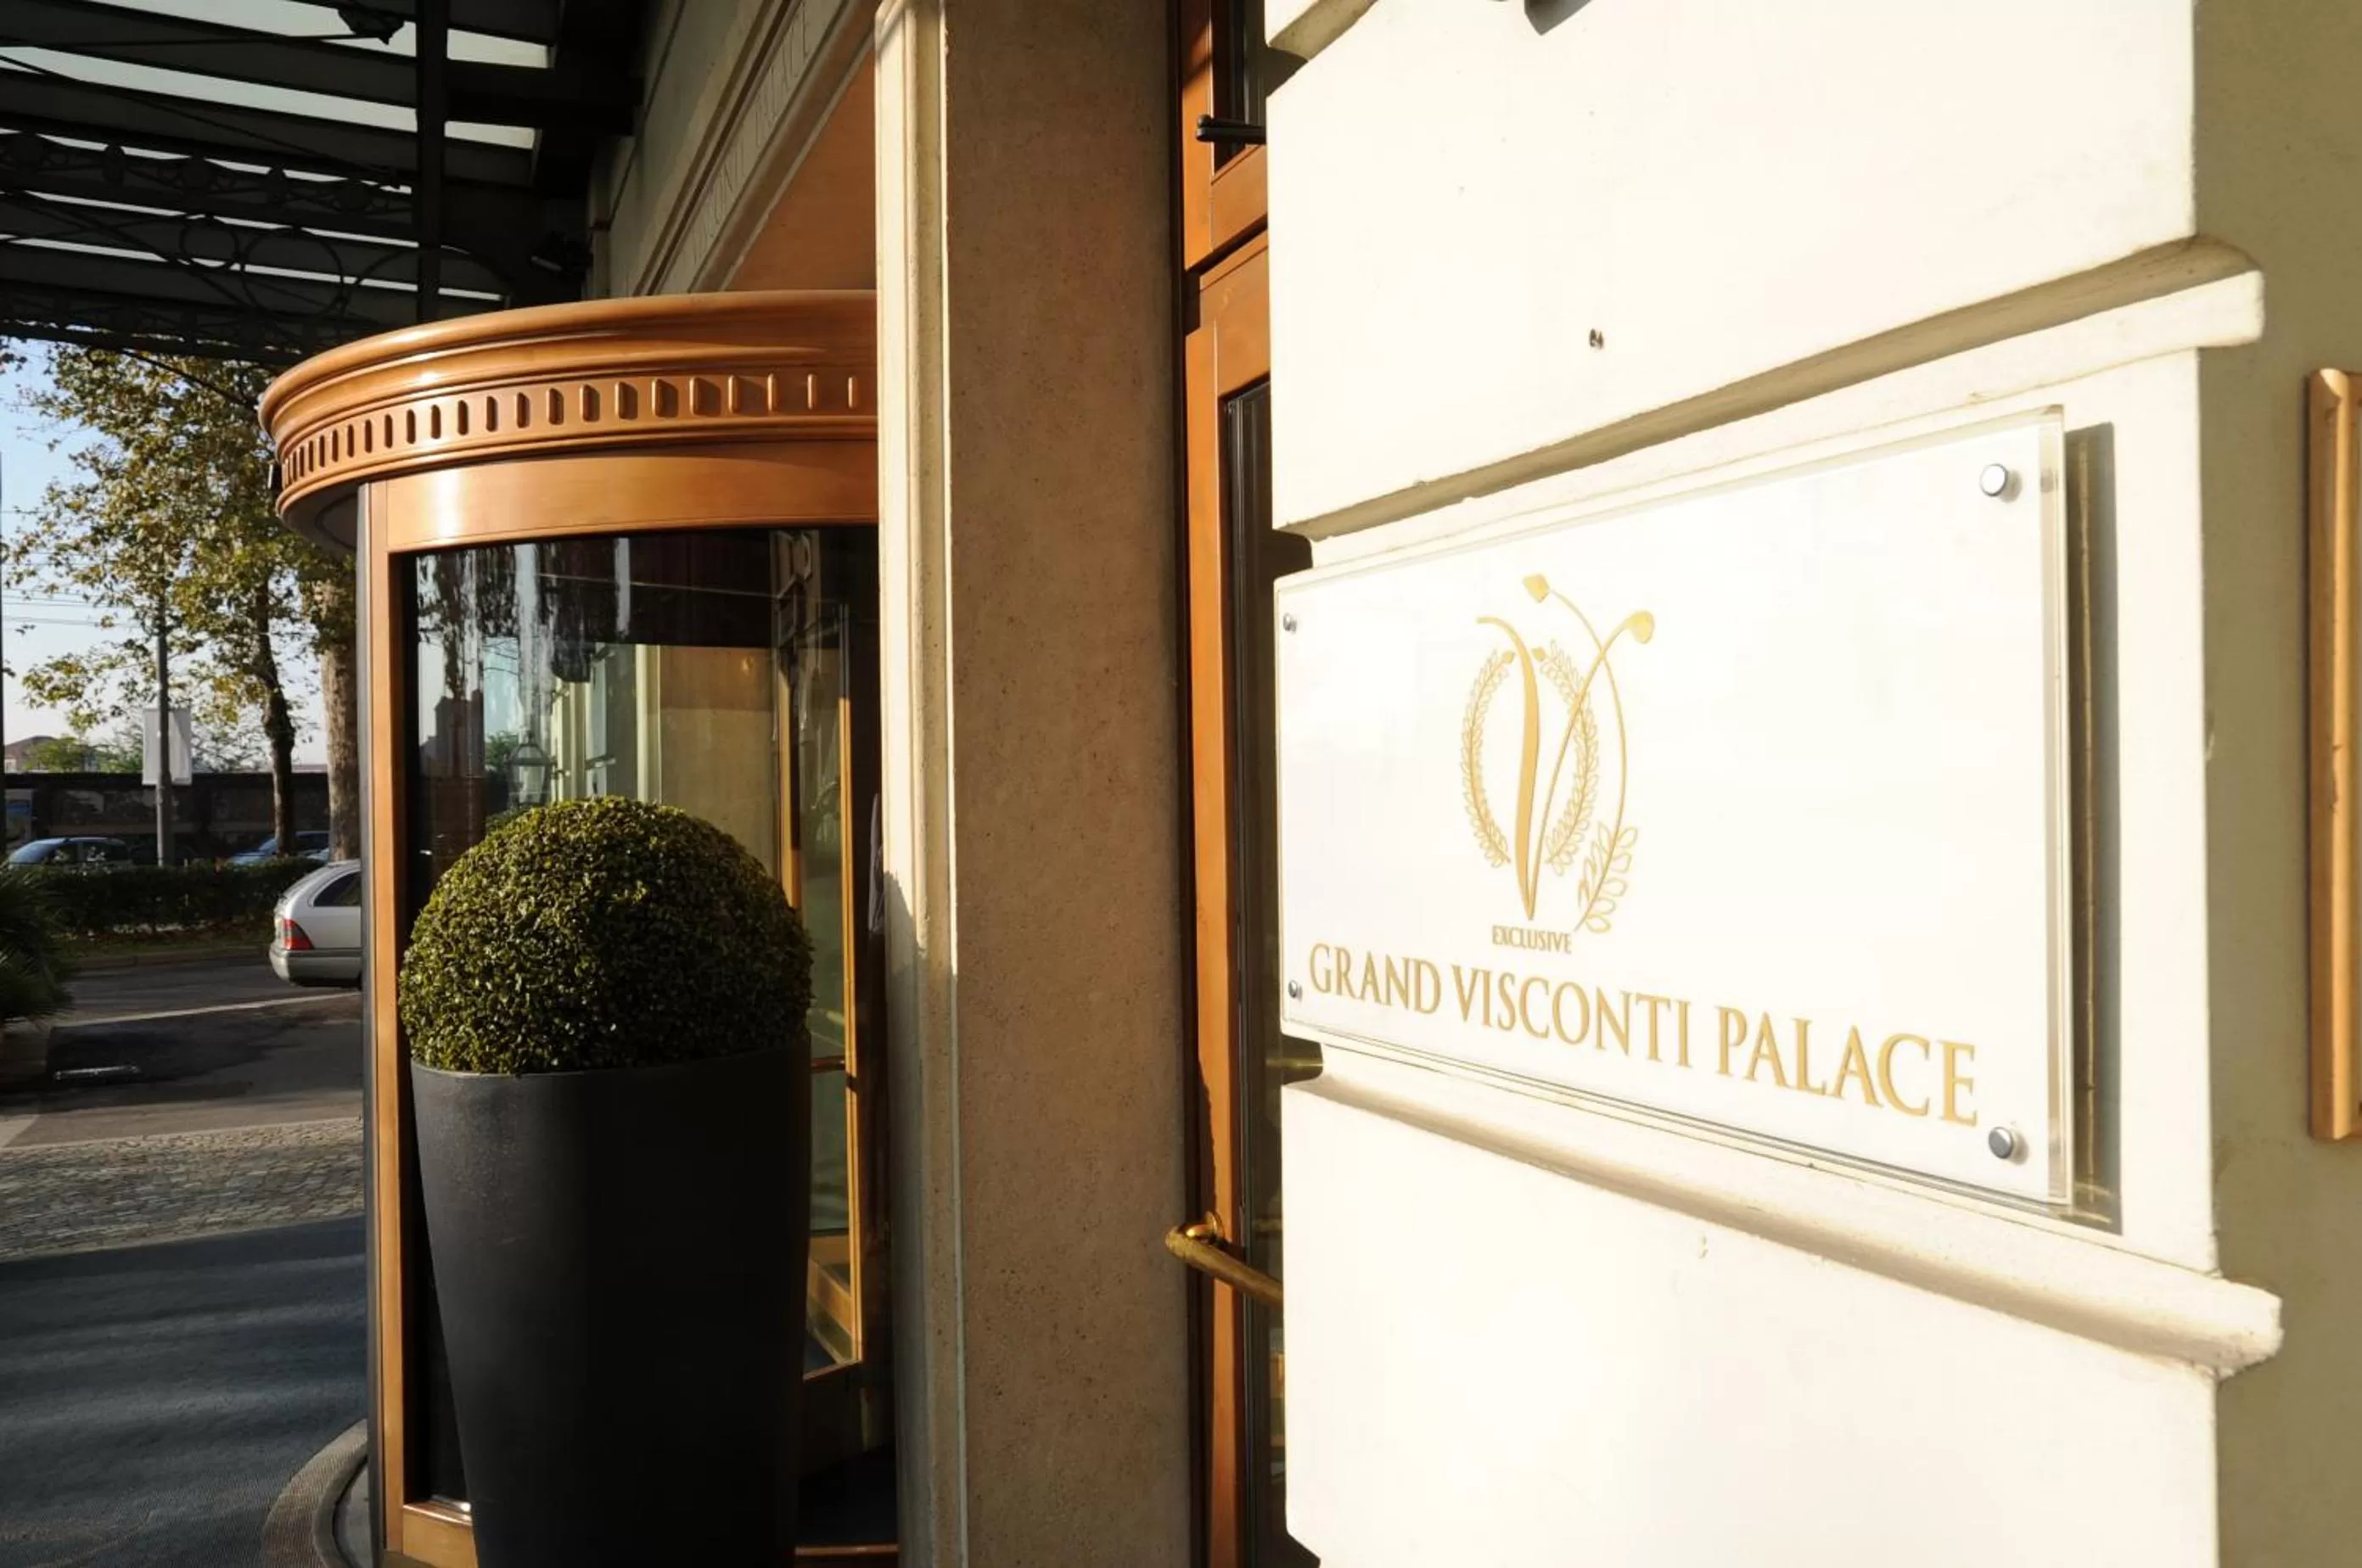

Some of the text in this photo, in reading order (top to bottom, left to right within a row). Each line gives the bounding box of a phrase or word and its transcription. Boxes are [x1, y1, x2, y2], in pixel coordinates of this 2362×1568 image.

[1491, 925, 1572, 954] EXCLUSIVE
[1309, 941, 1979, 1128] GRAND VISCONTI PALACE
